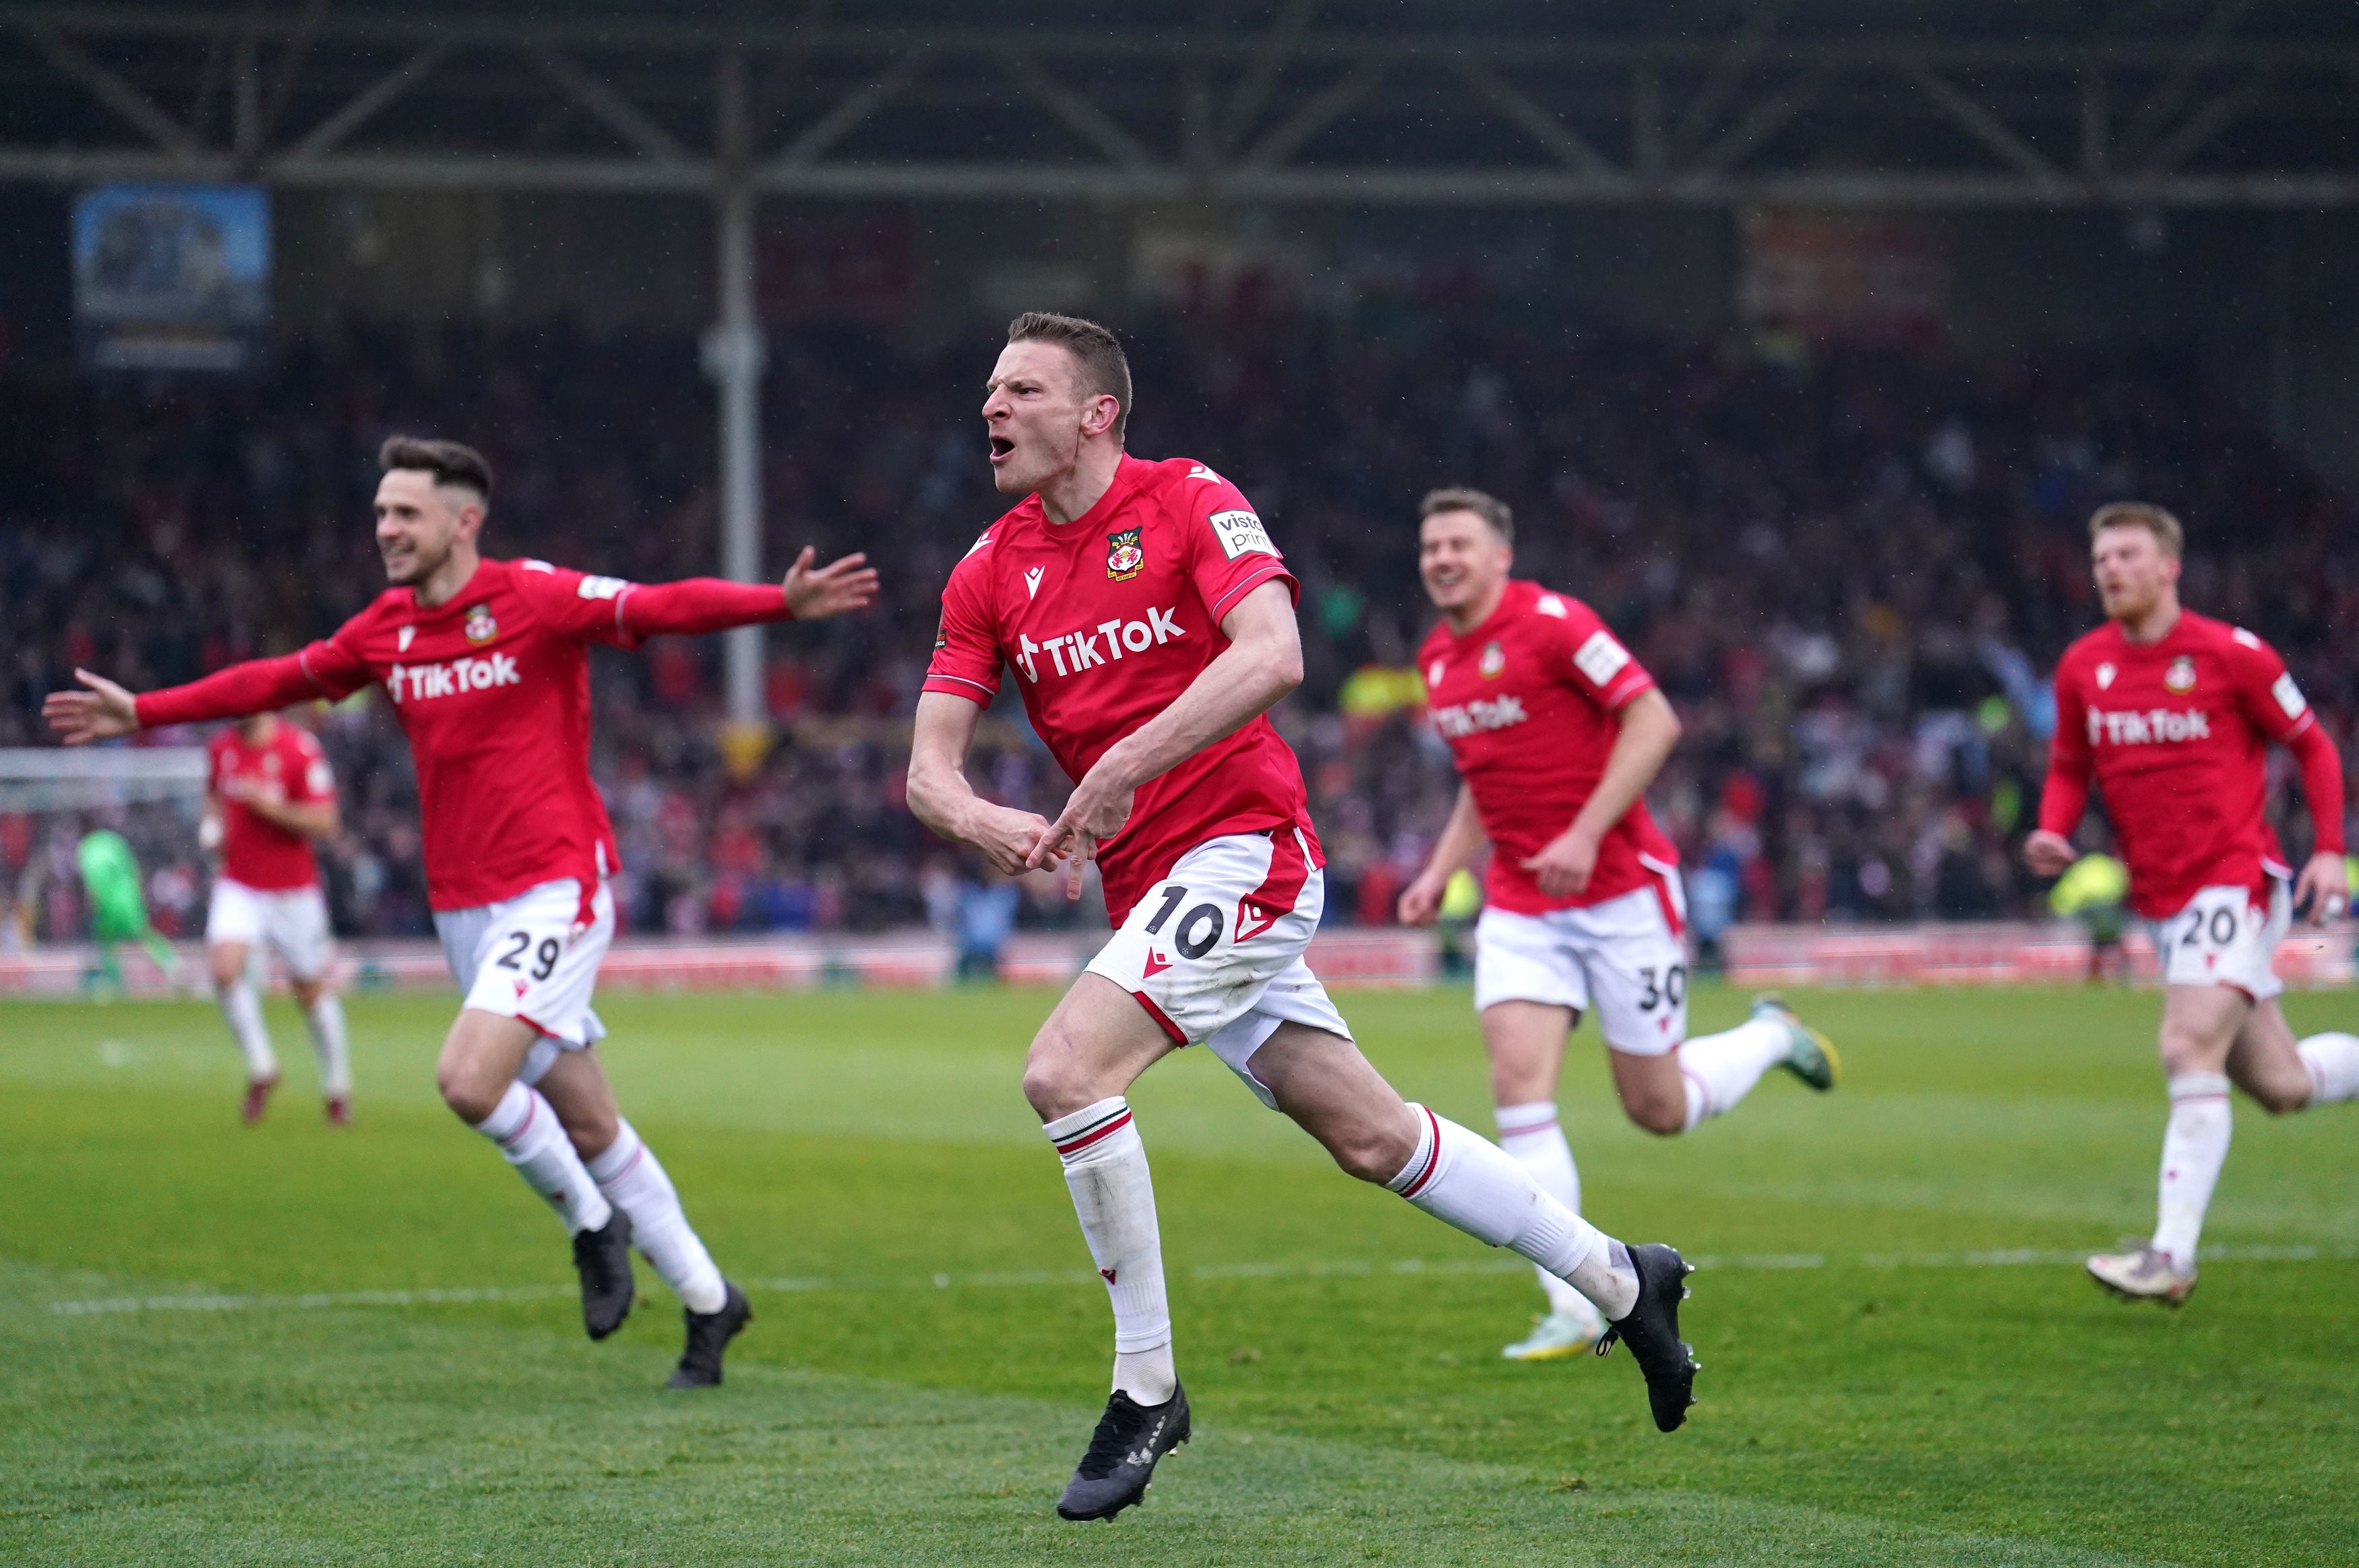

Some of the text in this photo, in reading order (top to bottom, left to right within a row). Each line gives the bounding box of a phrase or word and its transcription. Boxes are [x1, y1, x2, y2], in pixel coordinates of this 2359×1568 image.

[1042, 606, 1186, 677] TikTok
[407, 652, 520, 700] TikTok
[1144, 885, 1224, 960] 10
[2182, 906, 2237, 945] 20
[497, 931, 559, 981] 29
[1638, 964, 1685, 1010] 30
